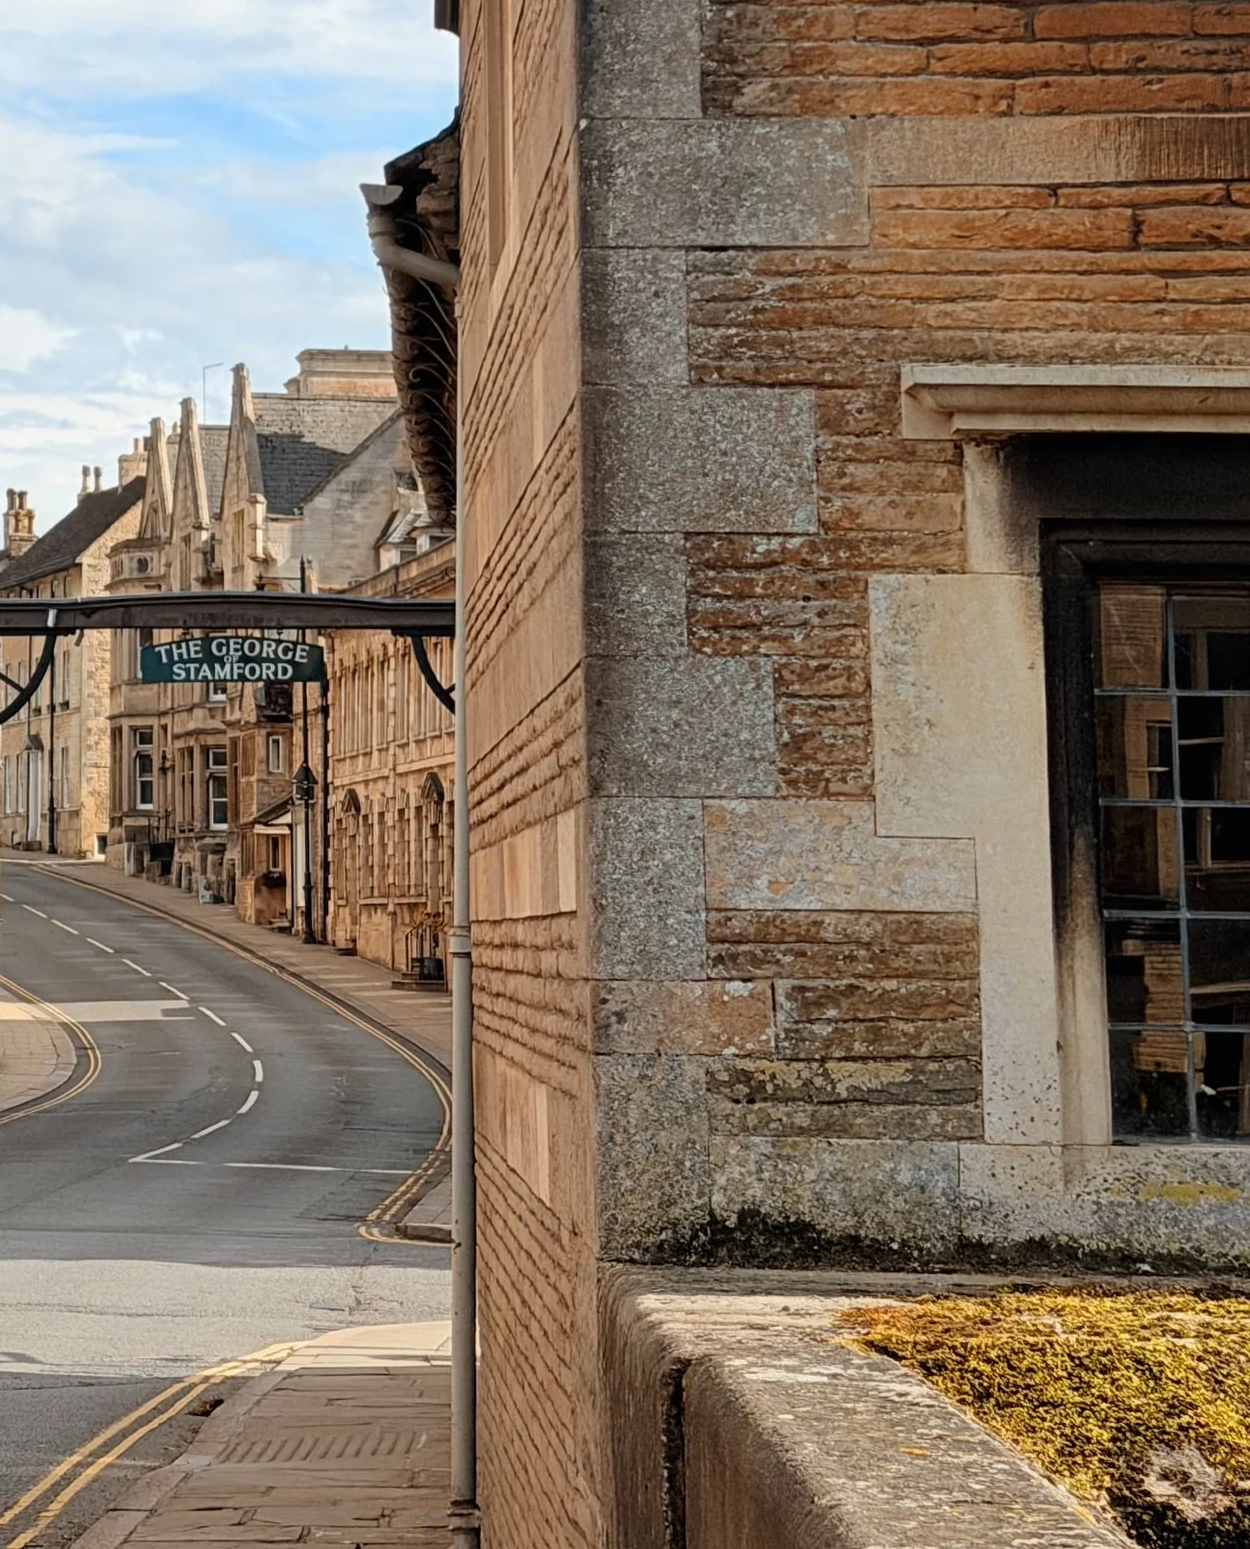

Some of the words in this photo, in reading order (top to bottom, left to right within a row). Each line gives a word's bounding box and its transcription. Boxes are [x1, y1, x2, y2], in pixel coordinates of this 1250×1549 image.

[155, 641, 203, 664] THE
[210, 638, 310, 663] GEORGE
[224, 654, 239, 664] OF
[172, 663, 293, 681] STAMFORD
